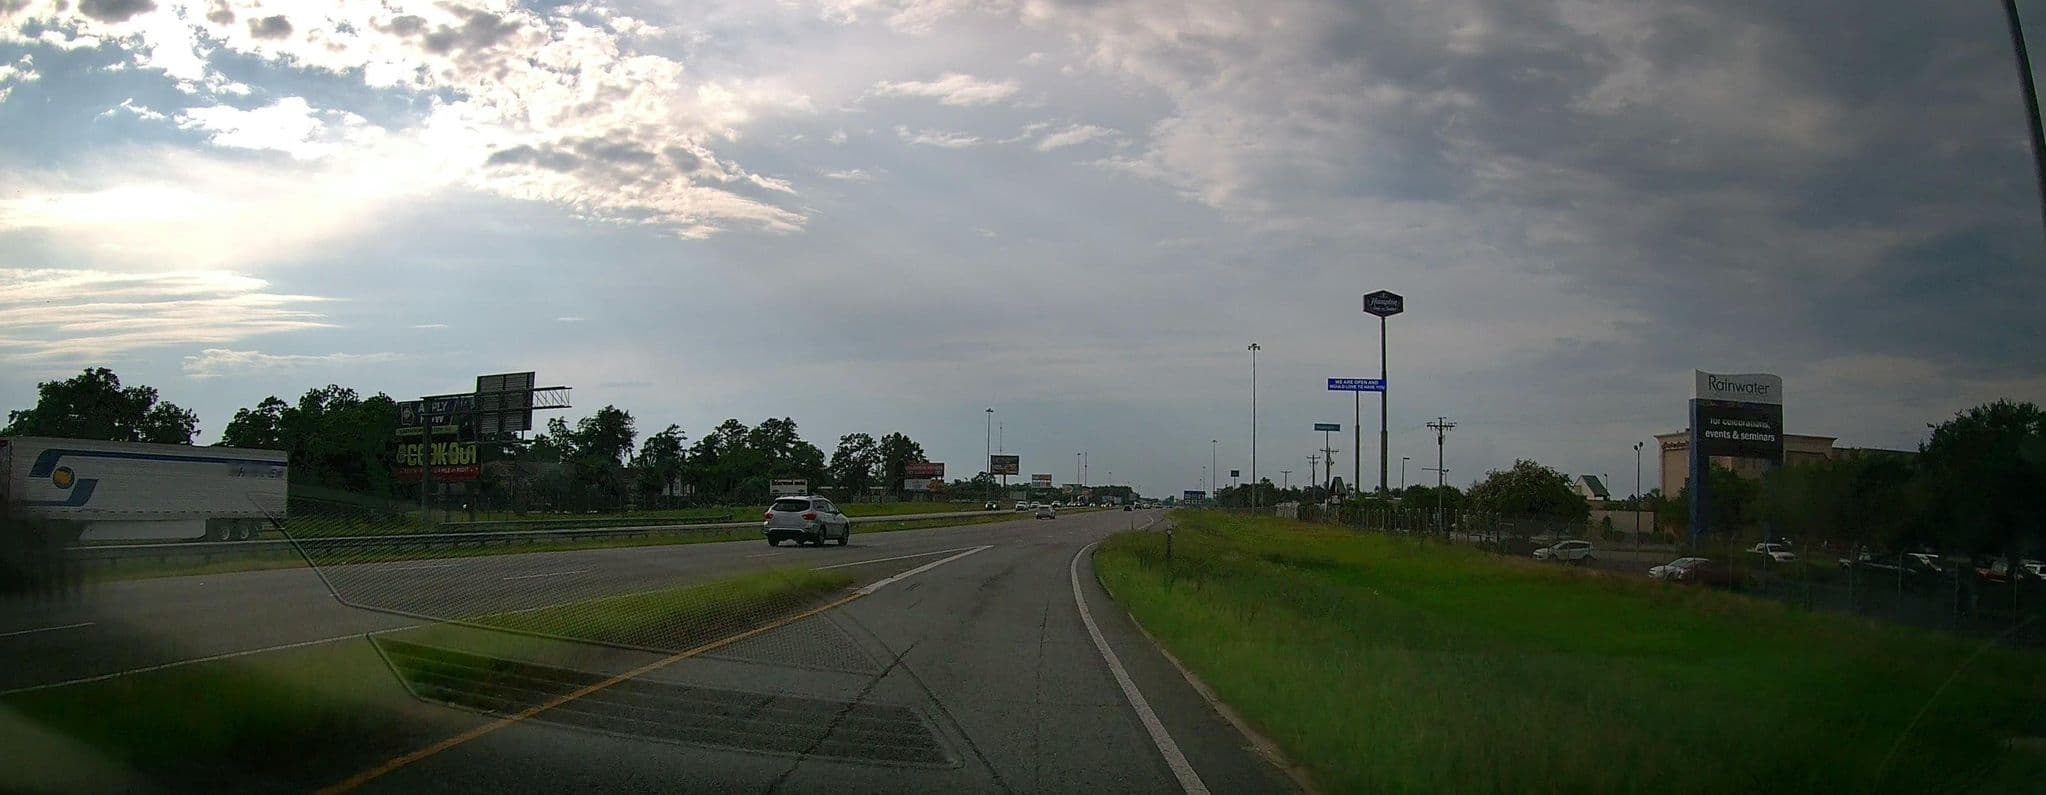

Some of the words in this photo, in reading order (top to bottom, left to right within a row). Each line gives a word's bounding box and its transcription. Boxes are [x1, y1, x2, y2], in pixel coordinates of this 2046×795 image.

[1708, 375, 1770, 395] Rainwater
[1705, 430, 1731, 440] events
[1732, 430, 1740, 440] &
[1740, 431, 1776, 442] seminars
